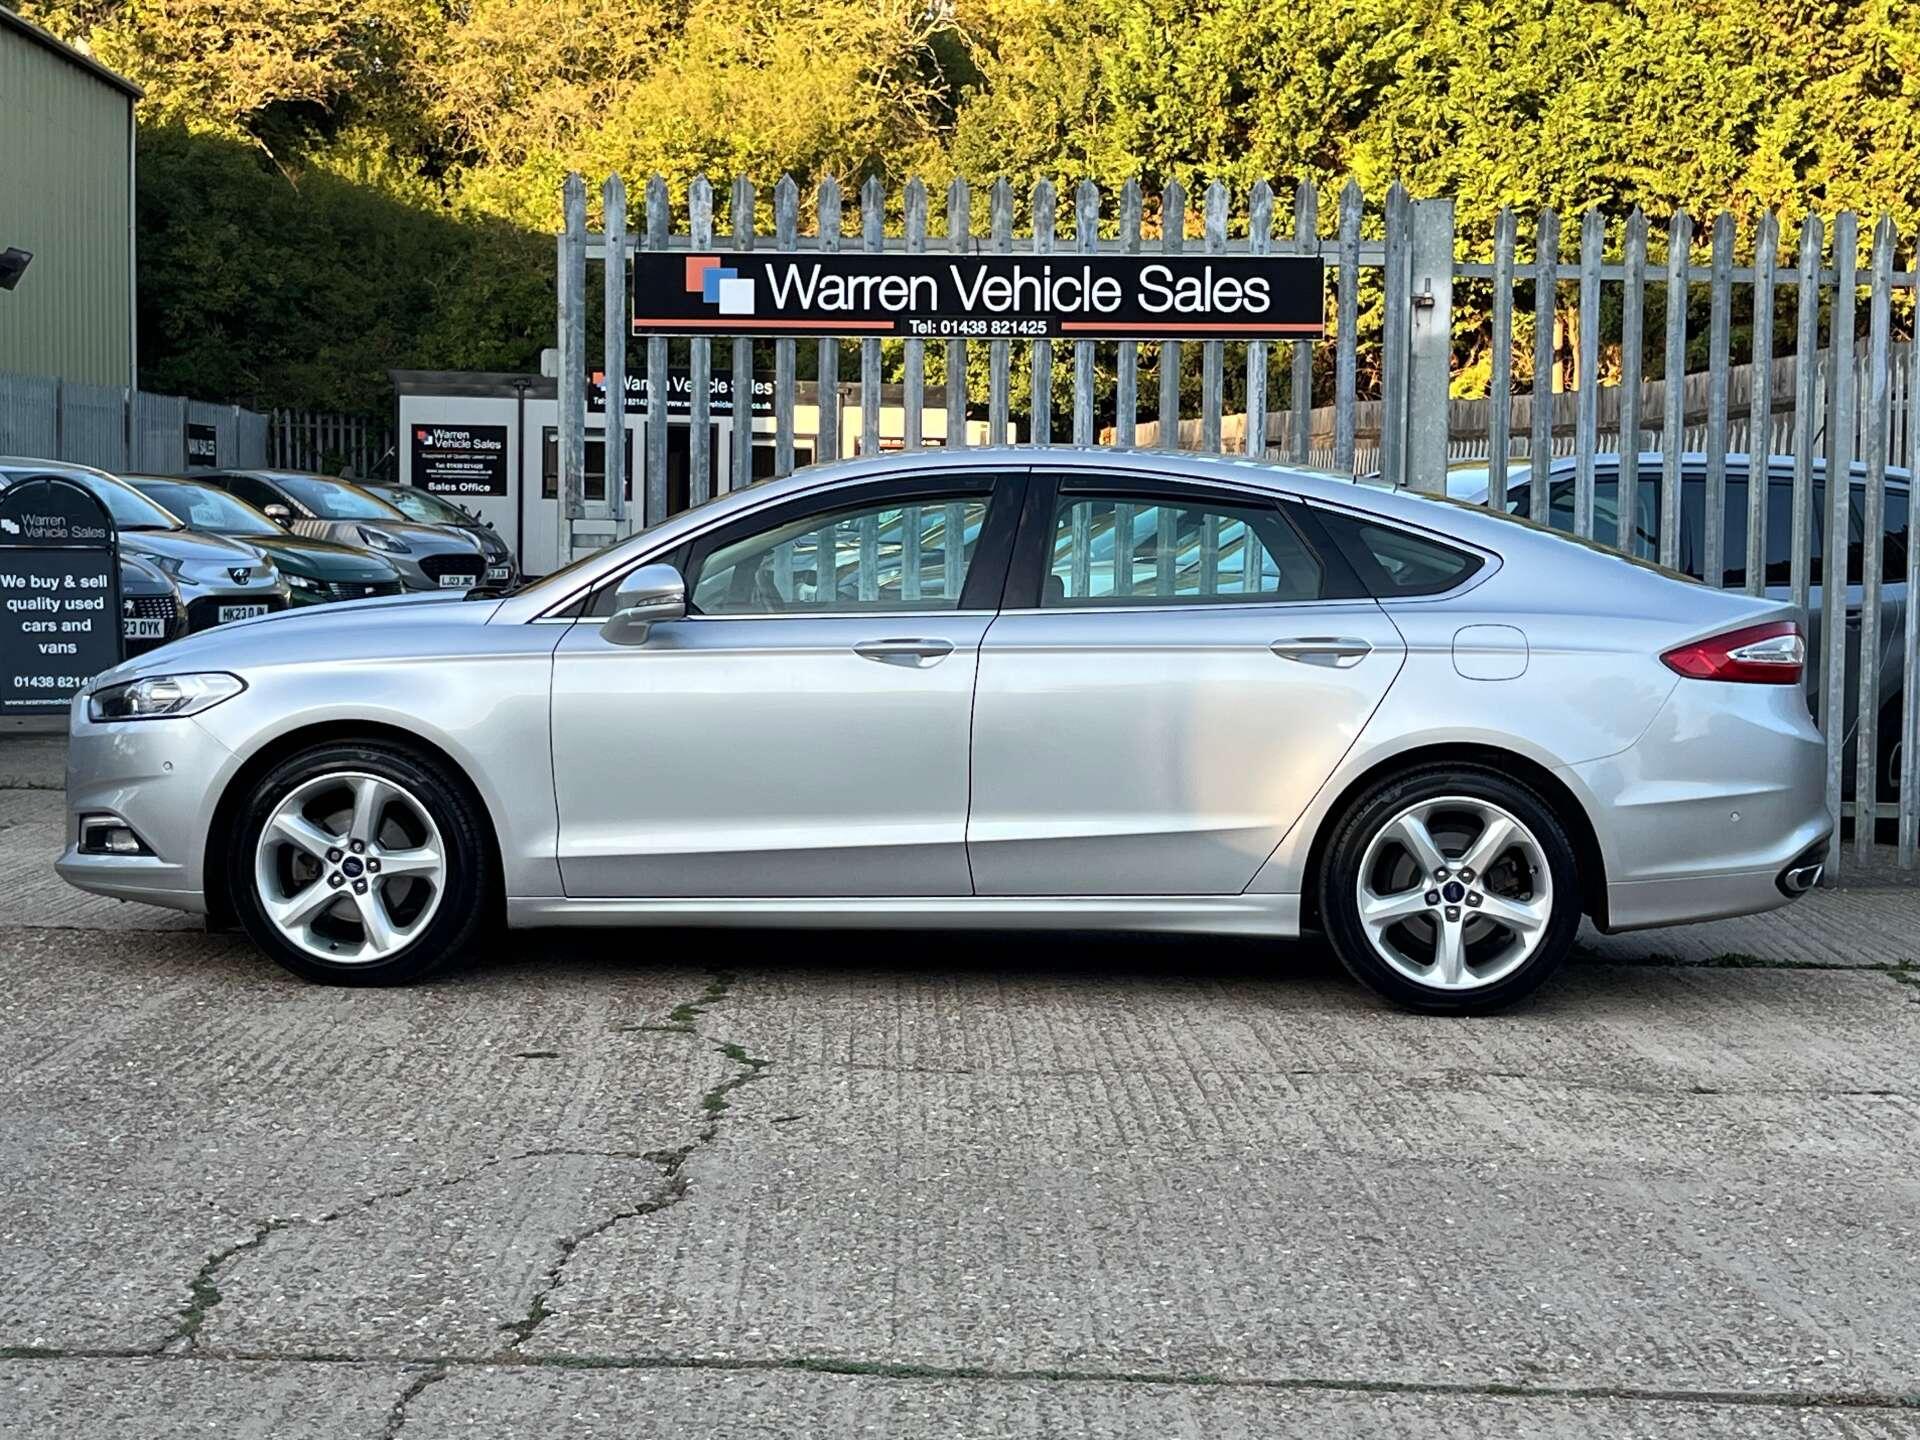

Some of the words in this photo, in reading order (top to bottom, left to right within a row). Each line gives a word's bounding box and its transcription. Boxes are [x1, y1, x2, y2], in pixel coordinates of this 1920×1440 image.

[765, 263, 938, 311] Warren
[950, 264, 1122, 312] Vehicle
[1138, 264, 1271, 313] Sales
[909, 320, 937, 335] Tel:
[941, 320, 987, 335] 01438
[991, 320, 1047, 335] 821425
[433, 429, 470, 439] Warren
[434, 439, 471, 449] Vehicle
[473, 439, 502, 449] Sales
[428, 482, 457, 491] Sales
[459, 482, 491, 492] Office
[21, 514, 66, 526] Warren
[24, 526, 68, 538] Vehicle
[71, 525, 106, 538] Sales
[0, 575, 26, 588] We
[30, 574, 60, 591] buy
[64, 575, 76, 588] &
[80, 574, 108, 588] sell
[6, 596, 60, 612] quality
[65, 596, 104, 610] used
[22, 621, 57, 633] cars
[61, 618, 92, 632] and
[139, 621, 161, 635] OYK
[38, 643, 77, 654] vans
[14, 676, 55, 687] 01438
